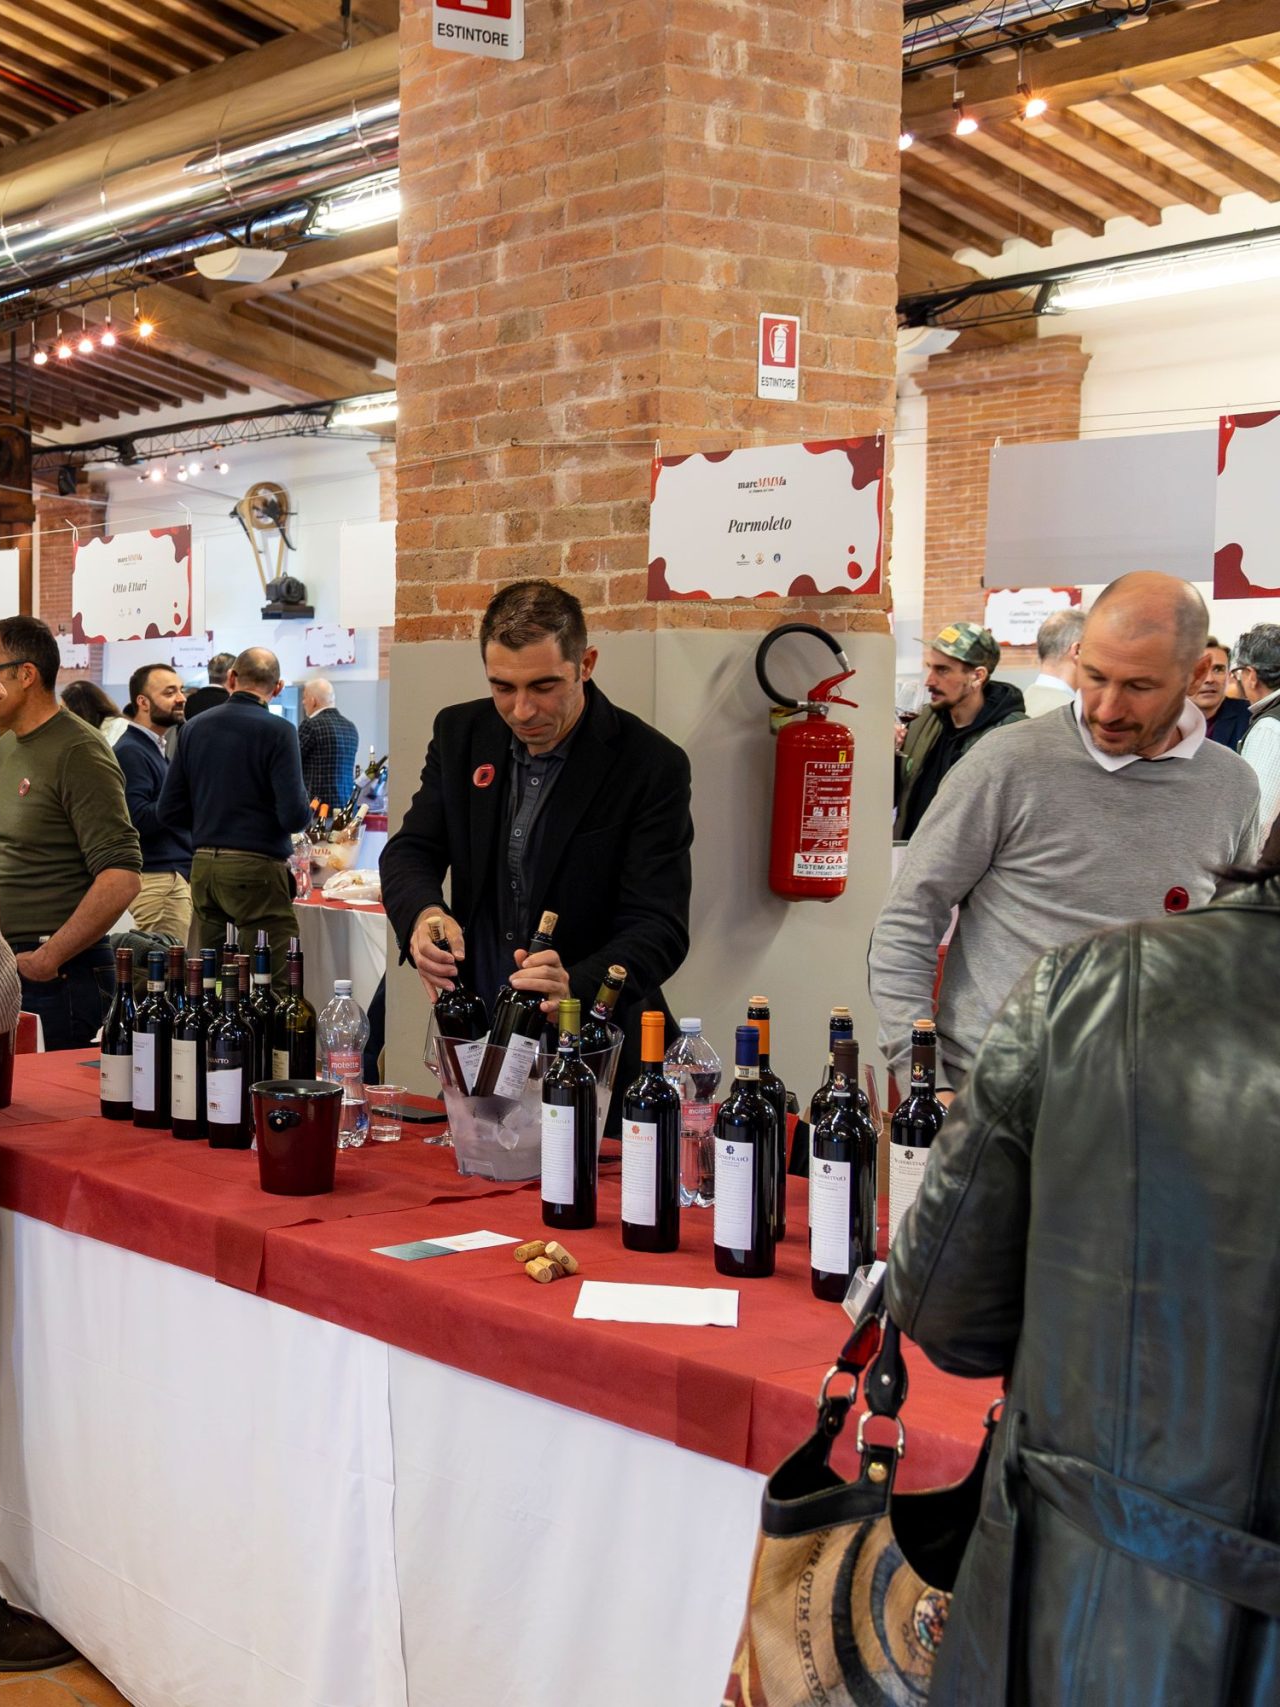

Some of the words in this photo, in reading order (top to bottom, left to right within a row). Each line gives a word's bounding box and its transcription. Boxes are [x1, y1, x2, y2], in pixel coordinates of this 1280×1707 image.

[437, 22, 509, 47] ESTINTORE
[760, 376, 796, 389] ESTINTORE
[727, 515, 792, 533] Parmoleto
[800, 855, 843, 864] VEGA
